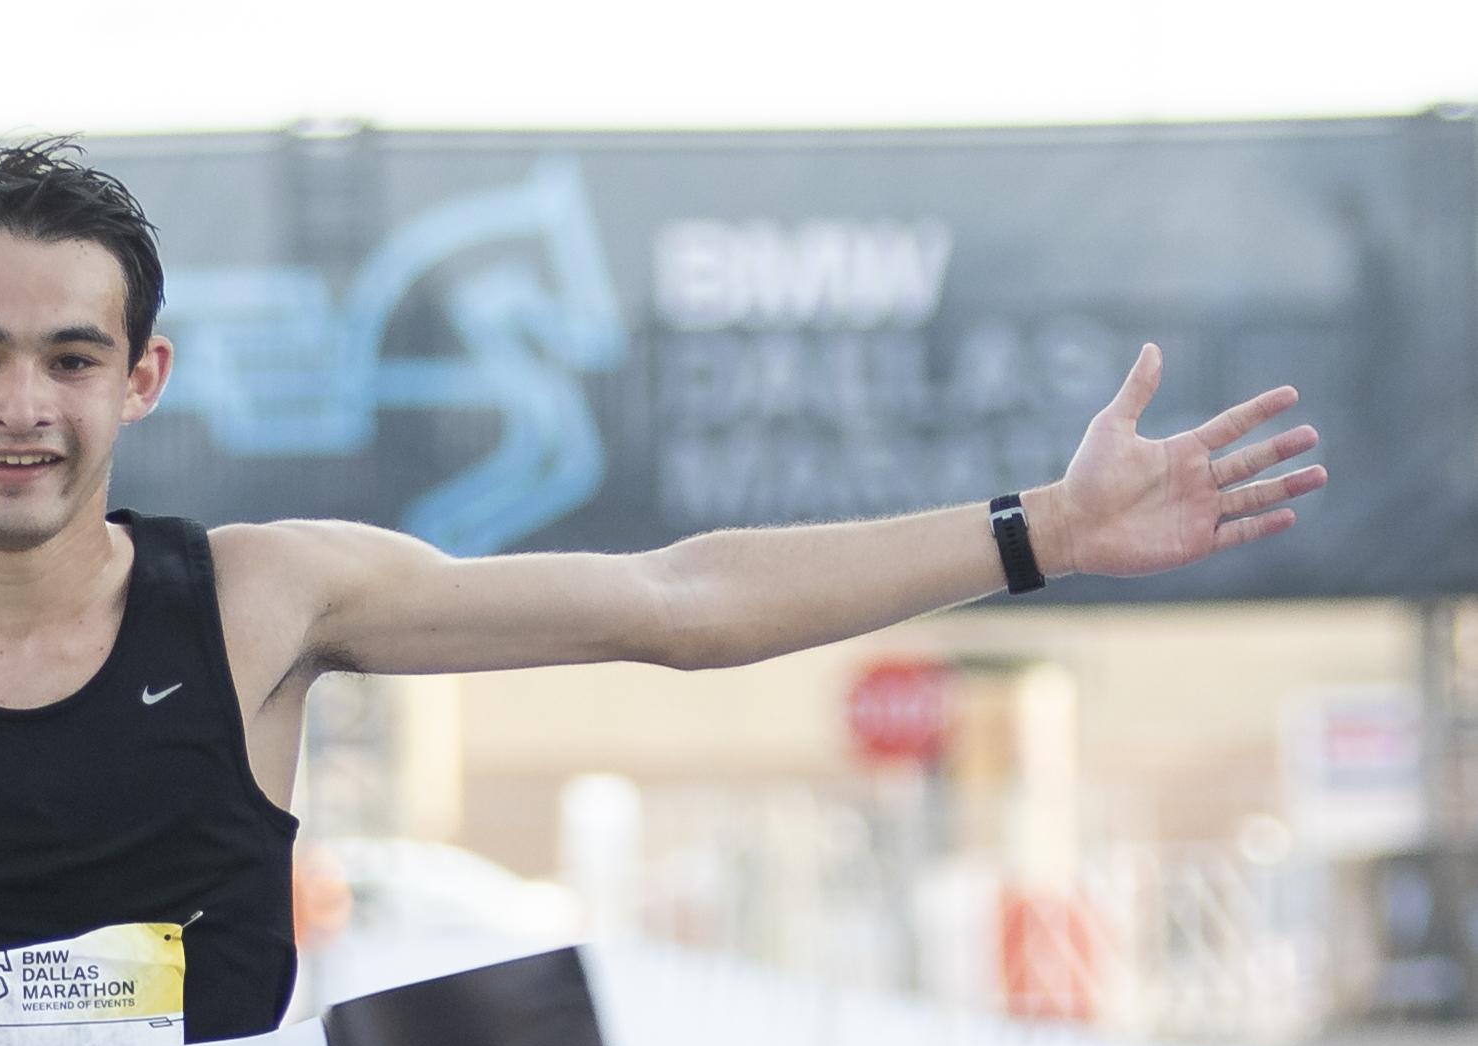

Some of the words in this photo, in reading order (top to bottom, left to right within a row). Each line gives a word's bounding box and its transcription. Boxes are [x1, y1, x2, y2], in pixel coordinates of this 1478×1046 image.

[652, 216, 952, 330] BMW
[22, 950, 69, 965] BMW
[22, 965, 99, 982] DALLAS
[23, 981, 135, 1000] MARATHON
[22, 1000, 75, 1011] WEEKEND
[76, 1000, 92, 1010] OF
[94, 998, 136, 1009] EVENTS
